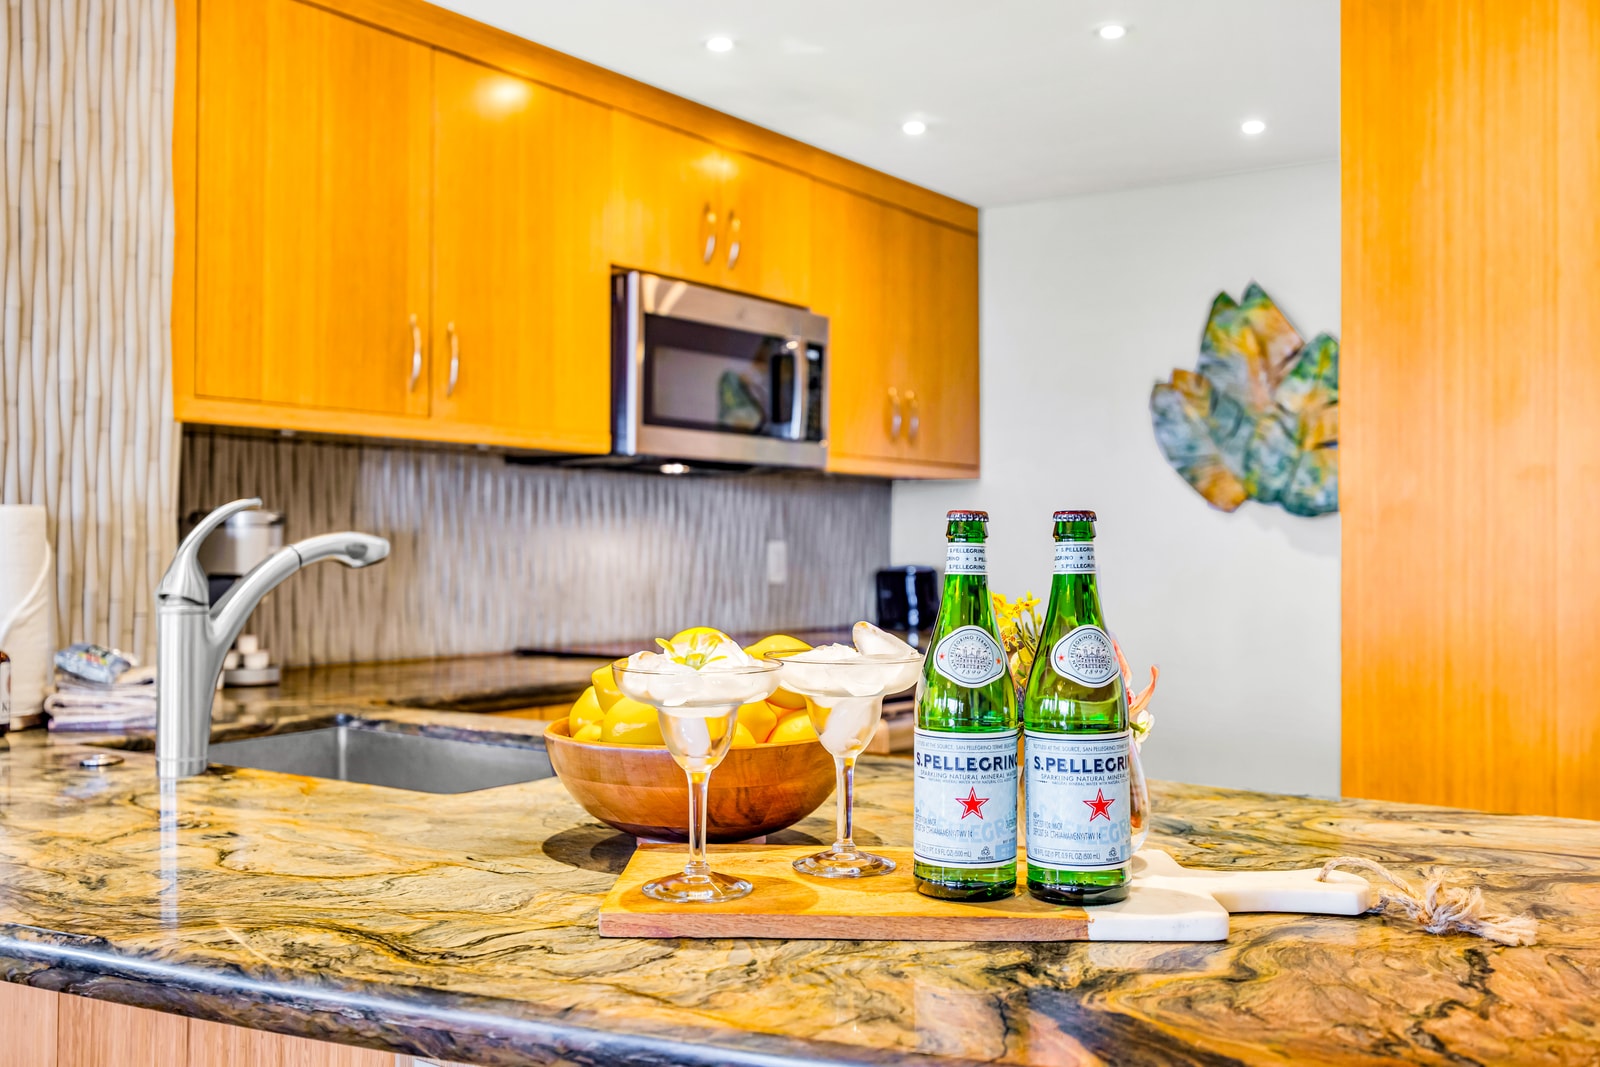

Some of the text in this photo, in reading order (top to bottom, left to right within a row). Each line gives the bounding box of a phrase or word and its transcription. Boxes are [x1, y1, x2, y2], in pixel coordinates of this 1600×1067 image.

[920, 769, 947, 779] SPARKLING
[1041, 773, 1074, 782] SPARKLING
[1107, 773, 1125, 781] MINERA
